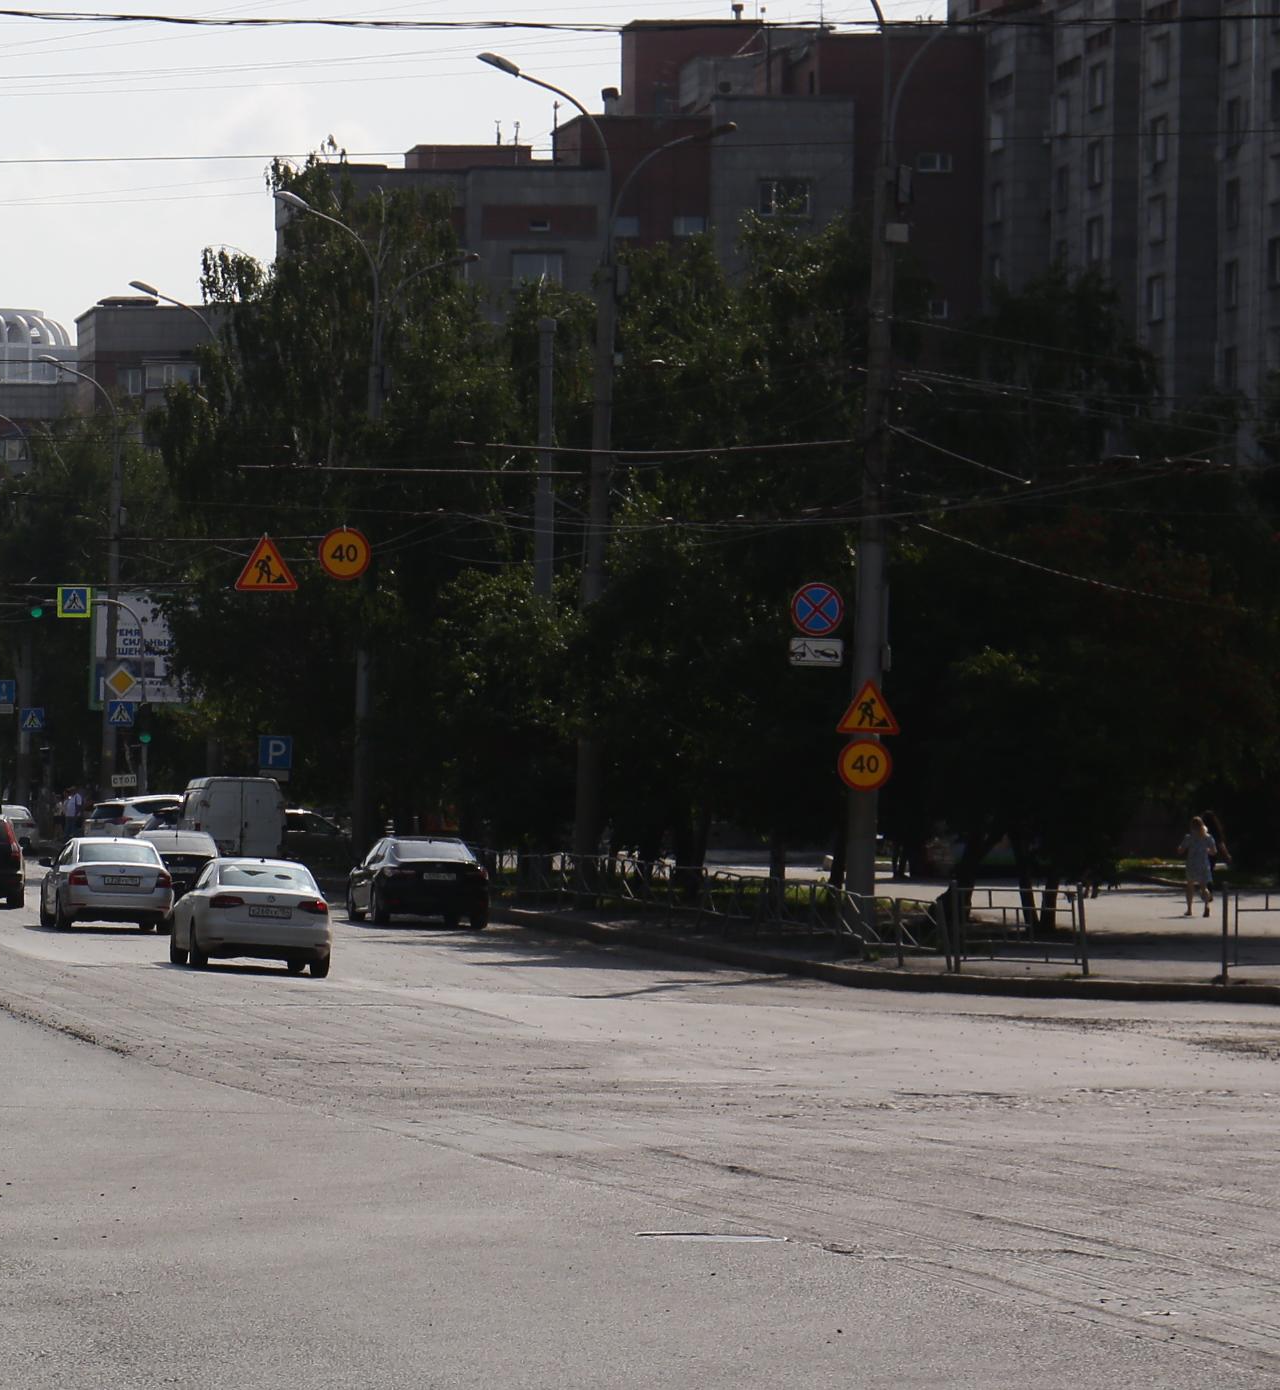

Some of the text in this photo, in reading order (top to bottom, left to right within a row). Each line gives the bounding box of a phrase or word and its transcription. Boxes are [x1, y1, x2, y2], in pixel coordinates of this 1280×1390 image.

[331, 543, 358, 562] 40
[269, 740, 286, 765] P
[851, 754, 879, 773] 40
